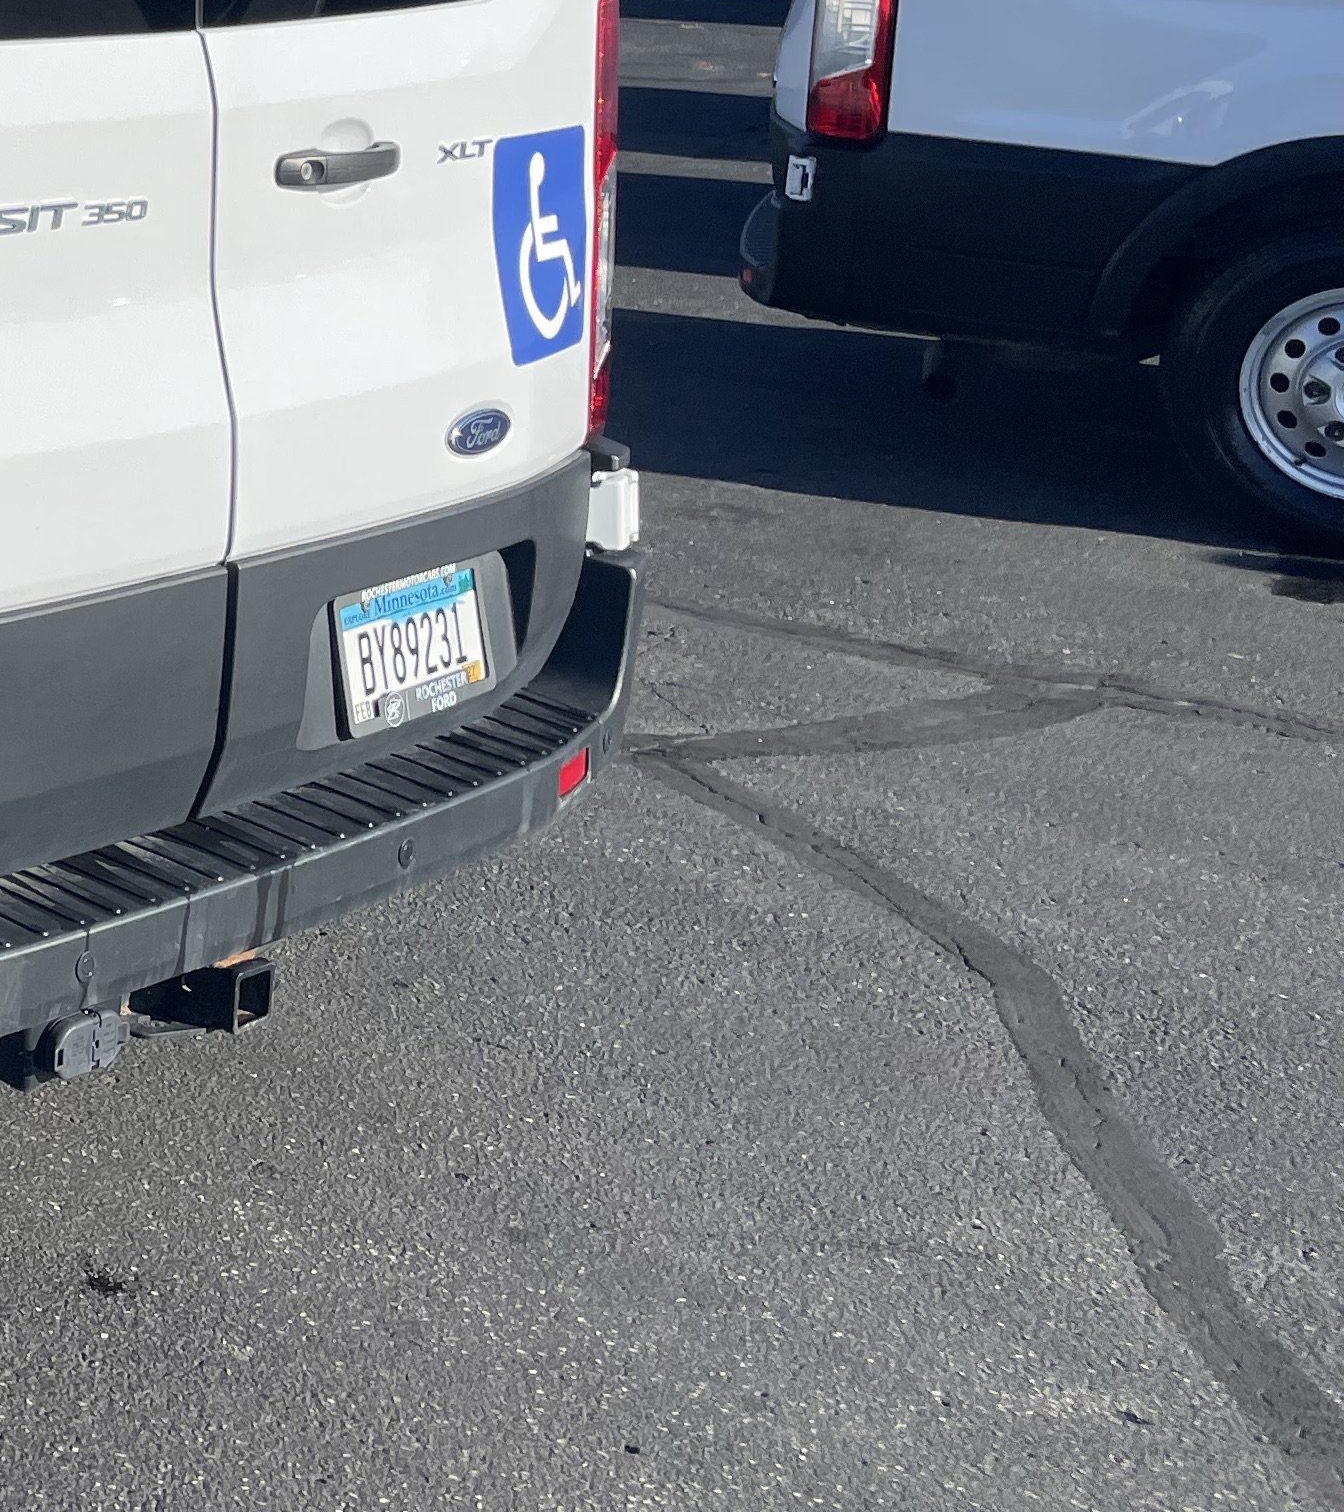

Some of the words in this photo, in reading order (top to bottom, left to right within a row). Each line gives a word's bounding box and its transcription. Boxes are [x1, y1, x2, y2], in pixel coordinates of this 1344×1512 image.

[437, 139, 493, 164] XLT
[81, 198, 149, 228] 350
[466, 416, 501, 448] Ford
[357, 602, 468, 696] BY89231
[355, 700, 372, 723] FEB
[431, 691, 457, 713] FORD
